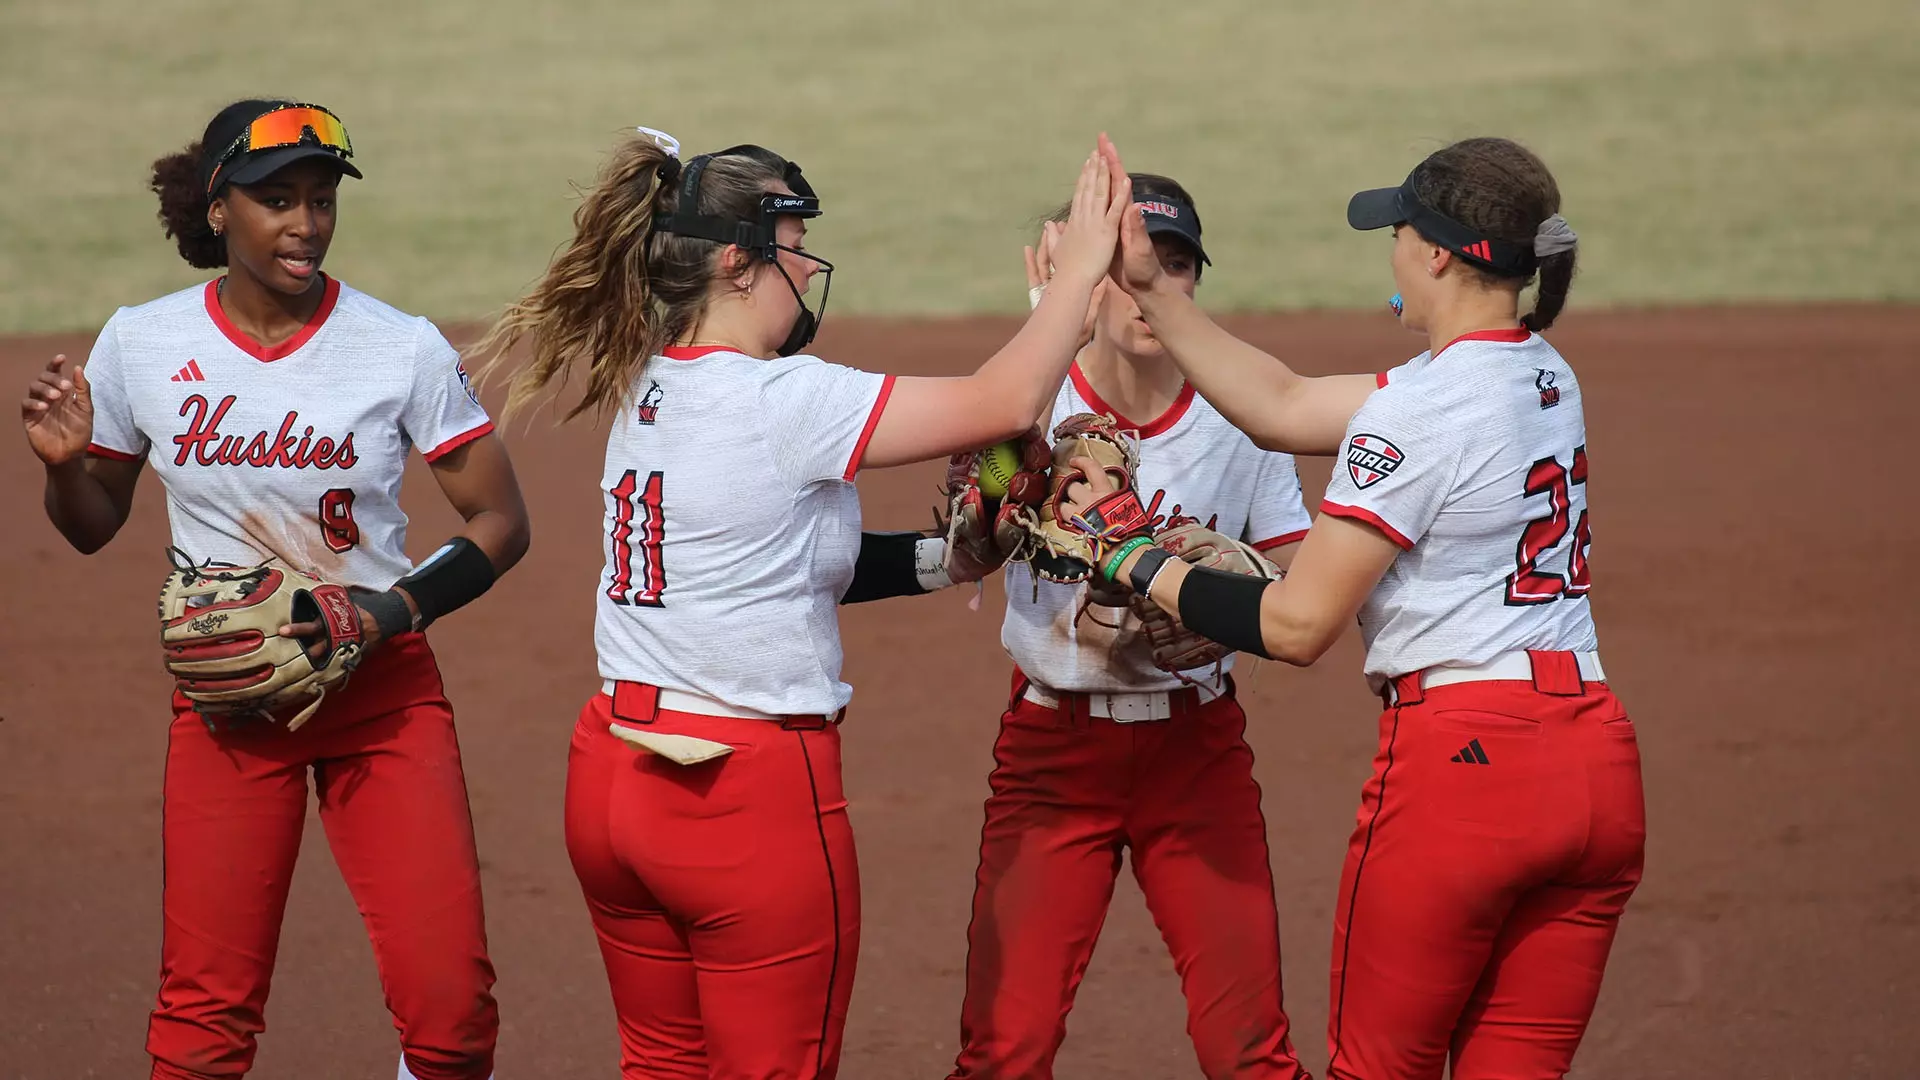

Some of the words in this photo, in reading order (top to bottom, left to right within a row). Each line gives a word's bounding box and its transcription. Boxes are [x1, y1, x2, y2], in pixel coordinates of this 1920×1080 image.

[1140, 201, 1178, 218] NIU
[173, 394, 359, 470] Huskies
[1348, 447, 1396, 474] MAC
[606, 469, 667, 608] 11
[187, 613, 229, 635] Rawlings
